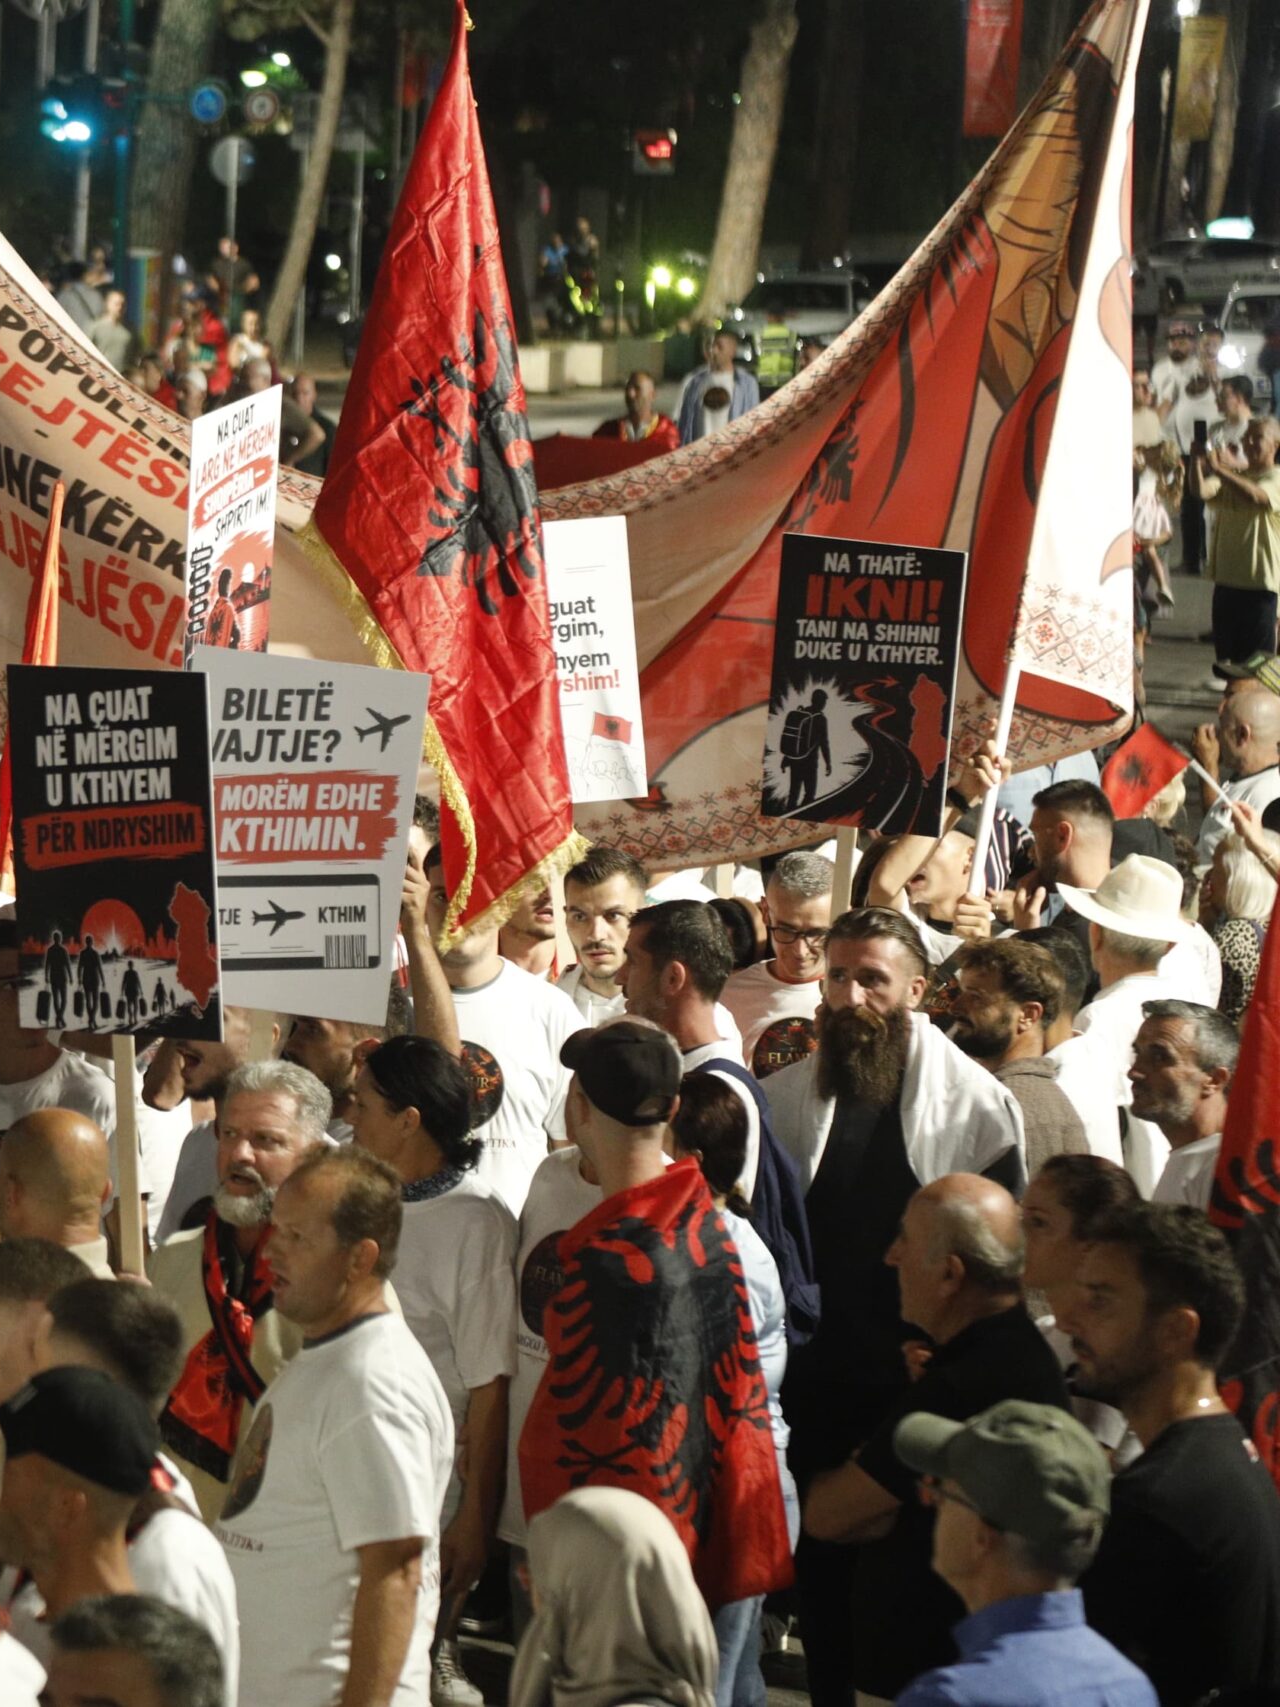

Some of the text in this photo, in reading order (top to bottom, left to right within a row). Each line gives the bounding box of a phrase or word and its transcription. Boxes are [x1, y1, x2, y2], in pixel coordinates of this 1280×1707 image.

[217, 419, 228, 444] NA
[195, 453, 220, 493] LARG
[61, 478, 187, 581] KËRK
[215, 499, 252, 541] SHPIRTI
[824, 551, 922, 576] NA THATË:
[548, 596, 596, 622] guat
[806, 574, 944, 624] IKNI!
[795, 619, 941, 644] TANI NA SHIHNI
[554, 651, 611, 674] hyem
[794, 640, 944, 665] DUKE U KTHYER.
[560, 668, 620, 692] shim!
[45, 686, 153, 730] NA ÇUAT
[221, 681, 334, 722] BILETË
[35, 724, 179, 768] NË MËRGIM
[46, 767, 172, 807] U KTHYEM
[220, 778, 385, 812] MORËM EDHE
[36, 812, 197, 855] PËR NDRYSHIM
[219, 815, 367, 853] KTHIMIN.
[218, 905, 367, 925] TJE KTHIM
